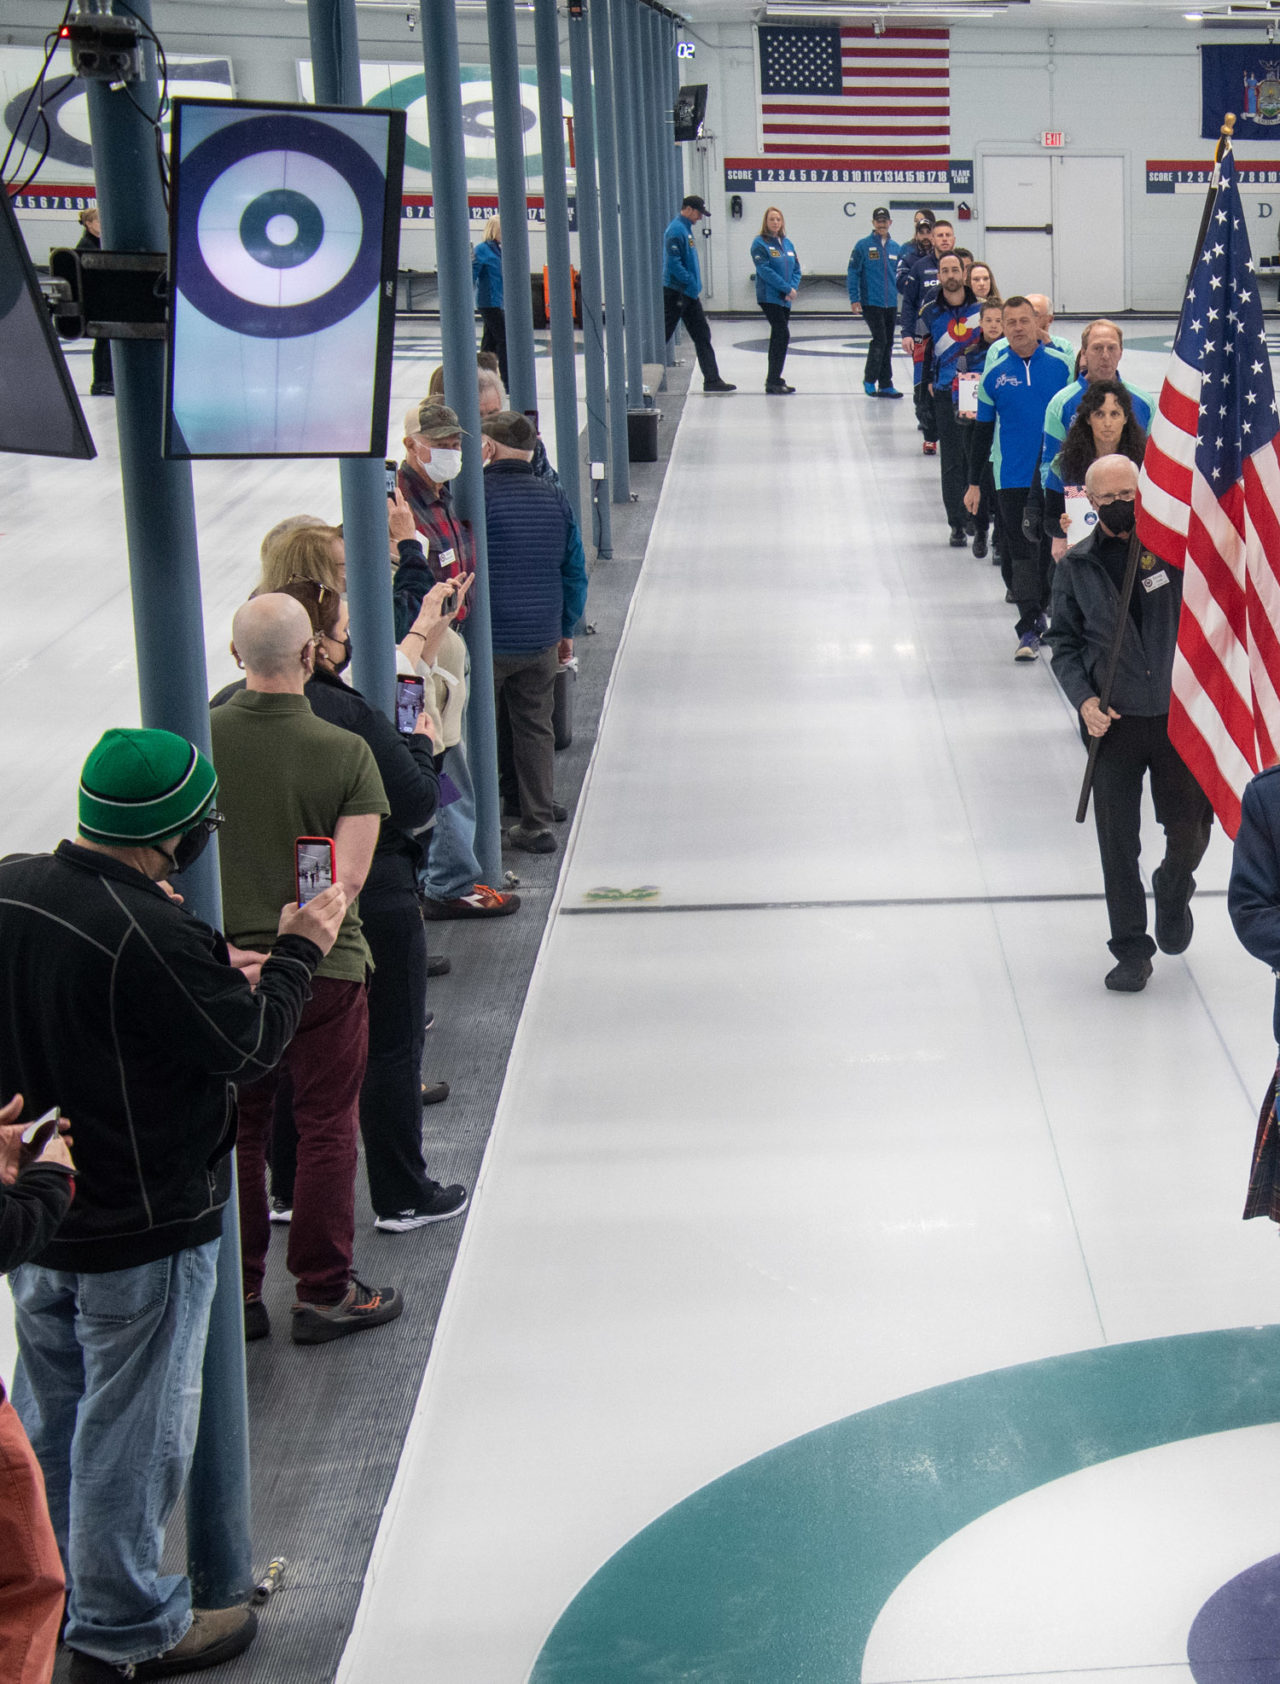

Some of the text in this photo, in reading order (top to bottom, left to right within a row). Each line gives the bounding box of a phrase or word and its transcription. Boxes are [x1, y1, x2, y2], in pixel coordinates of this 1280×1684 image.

[677, 41, 696, 59] 02
[1045, 132, 1062, 146] EXIT
[727, 169, 947, 182] SCORE 1 2 3 4 5 6 7 8 9 10 11 12 13 14 15 16 17 18
[1149, 172, 1173, 182] SCORE
[1177, 171, 1182, 183] 1
[1187, 171, 1194, 183] 2
[1197, 171, 1204, 183] 3
[1239, 171, 1245, 183] 7
[1249, 171, 1255, 183] 8
[1259, 171, 1265, 183] 9
[1268, 171, 1277, 183] 10
[15, 196, 97, 209] 4 5 6 7 8 9 10
[844, 202, 856, 217] C
[406, 206, 413, 218] 6
[418, 206, 424, 218] 7
[472, 207, 482, 219] 12
[484, 207, 493, 219] 13
[528, 208, 537, 220] 17
[1258, 203, 1273, 218] D
